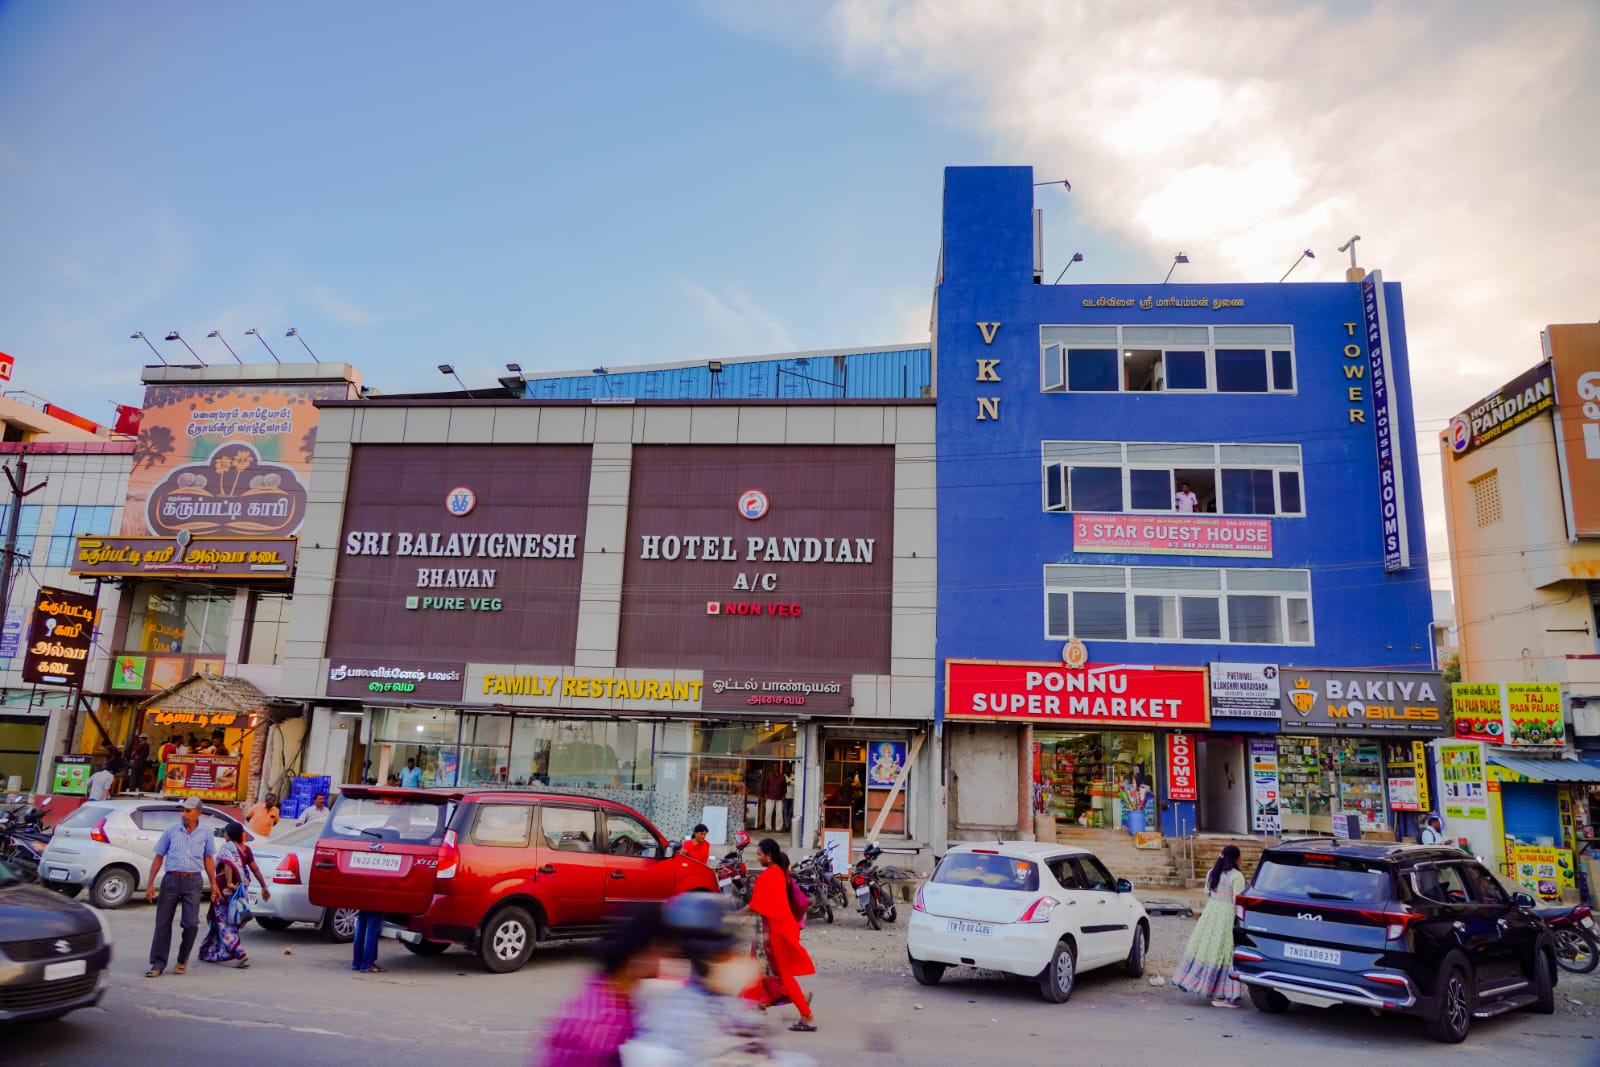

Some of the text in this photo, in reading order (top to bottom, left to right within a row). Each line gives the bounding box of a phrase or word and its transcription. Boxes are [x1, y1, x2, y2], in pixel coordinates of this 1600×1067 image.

[1344, 322, 1365, 423] TOWER
[1371, 347, 1385, 398] GUEST
[1471, 395, 1505, 421] HOTEL
[1472, 377, 1551, 436] PANDIAN
[1377, 405, 1390, 459] HOUSE
[1480, 423, 1503, 443] COFFEE
[163, 497, 288, 520] கருப்பட்டி காபி
[1382, 470, 1397, 551] ROOMS
[1078, 523, 1267, 543] 3 STAR GUEST HOUSE
[346, 531, 577, 558] SRI BALAVIGNESH
[640, 535, 875, 564] HOTEL PANDIAN
[78, 545, 285, 566] கருப்பட்டி காபி அல்வா கடை
[417, 568, 496, 589] BHAVAN
[733, 573, 777, 592] A/C
[38, 600, 93, 622] கருப்பட்டி
[422, 598, 503, 611] PURE VEG
[725, 602, 801, 617] NON VEG
[54, 623, 82, 638] காபி
[31, 641, 87, 660] அல்வா
[37, 661, 75, 676] கடை
[428, 671, 460, 682] பவன்
[369, 682, 415, 692] சைவம்
[483, 674, 704, 702] FAMILY RESTAURANT
[762, 680, 842, 696] பாண்டியன்
[1025, 671, 1128, 694] PONNU
[1326, 679, 1437, 702] BAKIYA
[747, 694, 806, 705] அசைவம்
[972, 693, 1182, 719] SUPER MARKET
[1455, 699, 1501, 715] TAJ PAAN PALACE
[1510, 703, 1559, 713] PAAN PALACE
[1524, 693, 1543, 703] TAJ
[1328, 701, 1439, 720] MOBILES
[1173, 735, 1190, 787] ROOMS
[1415, 743, 1428, 809] SERVICE
